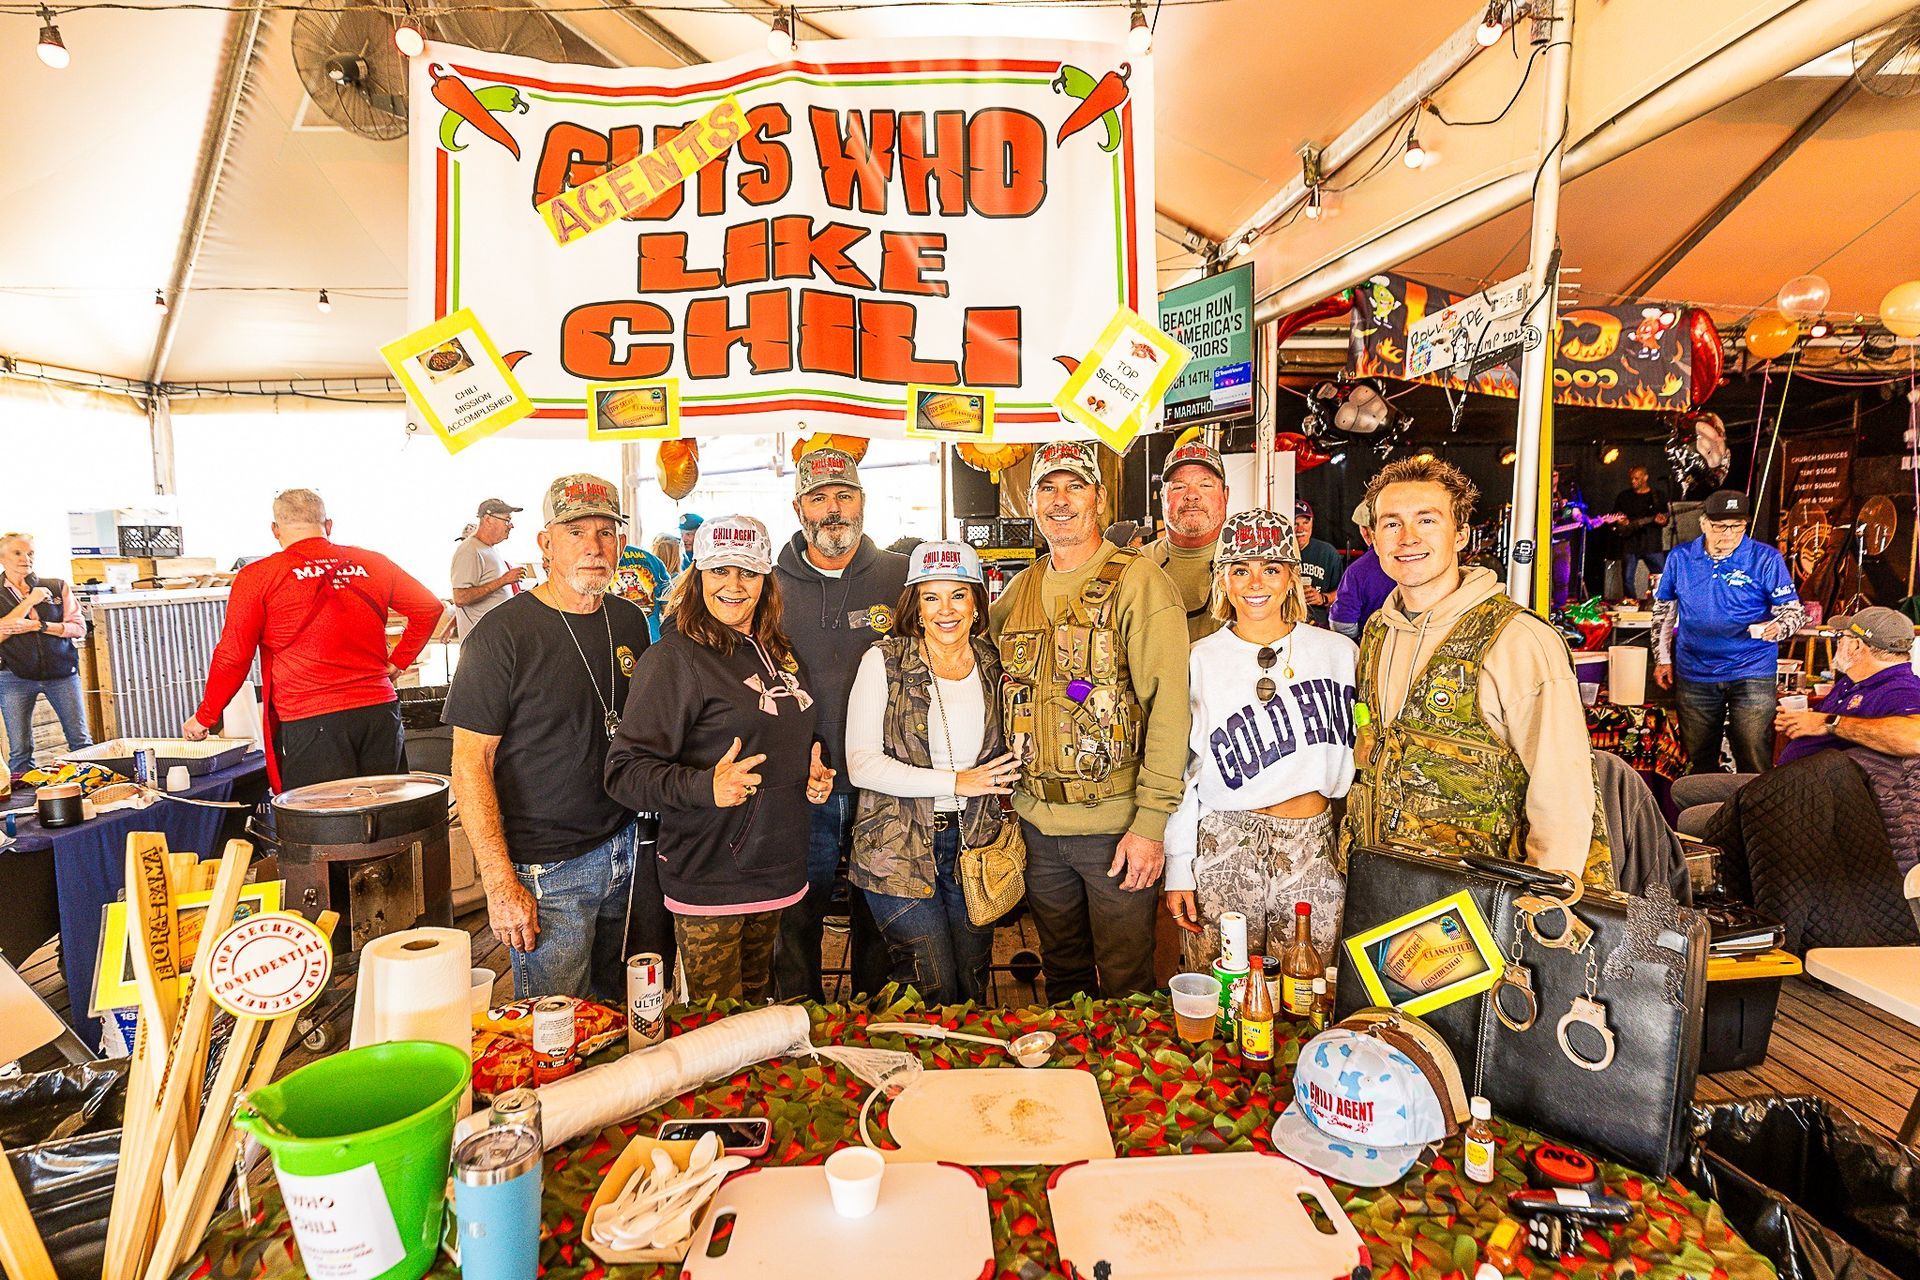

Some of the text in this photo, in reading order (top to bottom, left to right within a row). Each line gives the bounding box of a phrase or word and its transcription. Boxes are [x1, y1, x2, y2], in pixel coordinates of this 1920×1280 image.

[550, 103, 740, 244] AGENTS
[808, 106, 1048, 219] WHO
[637, 214, 949, 297] LIKE
[1163, 292, 1232, 333] BEACH RUN
[560, 286, 1023, 388] CHILI
[1176, 313, 1243, 345] AMERICA'S
[1191, 337, 1229, 361] RIORS
[1096, 367, 1140, 402] SECRET
[1116, 359, 1139, 380] TOP
[454, 384, 478, 401] CHILI
[454, 392, 493, 415] MISSION
[447, 394, 513, 433] ACCOMPLISHED
[1791, 451, 1848, 463] CHURCH SERVICES
[1816, 467, 1837, 475] STAGE
[586, 482, 608, 497] AGENT
[1794, 481, 1841, 491] EVERY SUNDAY
[713, 528, 756, 541] CHILI AGENT
[922, 551, 961, 564] CHILI AGENT
[1299, 562, 1325, 580] ARBOR
[1209, 694, 1296, 791] GOLD
[217, 944, 232, 973] TOP
[238, 923, 306, 941] SECRET
[1393, 937, 1425, 974] TOP SECRET
[1424, 940, 1473, 961] CLASSIFIED
[215, 940, 323, 995] CONFIDENTIAL
[1424, 955, 1463, 987] CONFIDENTIAL
[236, 960, 322, 1009] TOP SECRET
[1309, 1080, 1374, 1123] CHILI AGENT
[1543, 1149, 1587, 1168] NO
